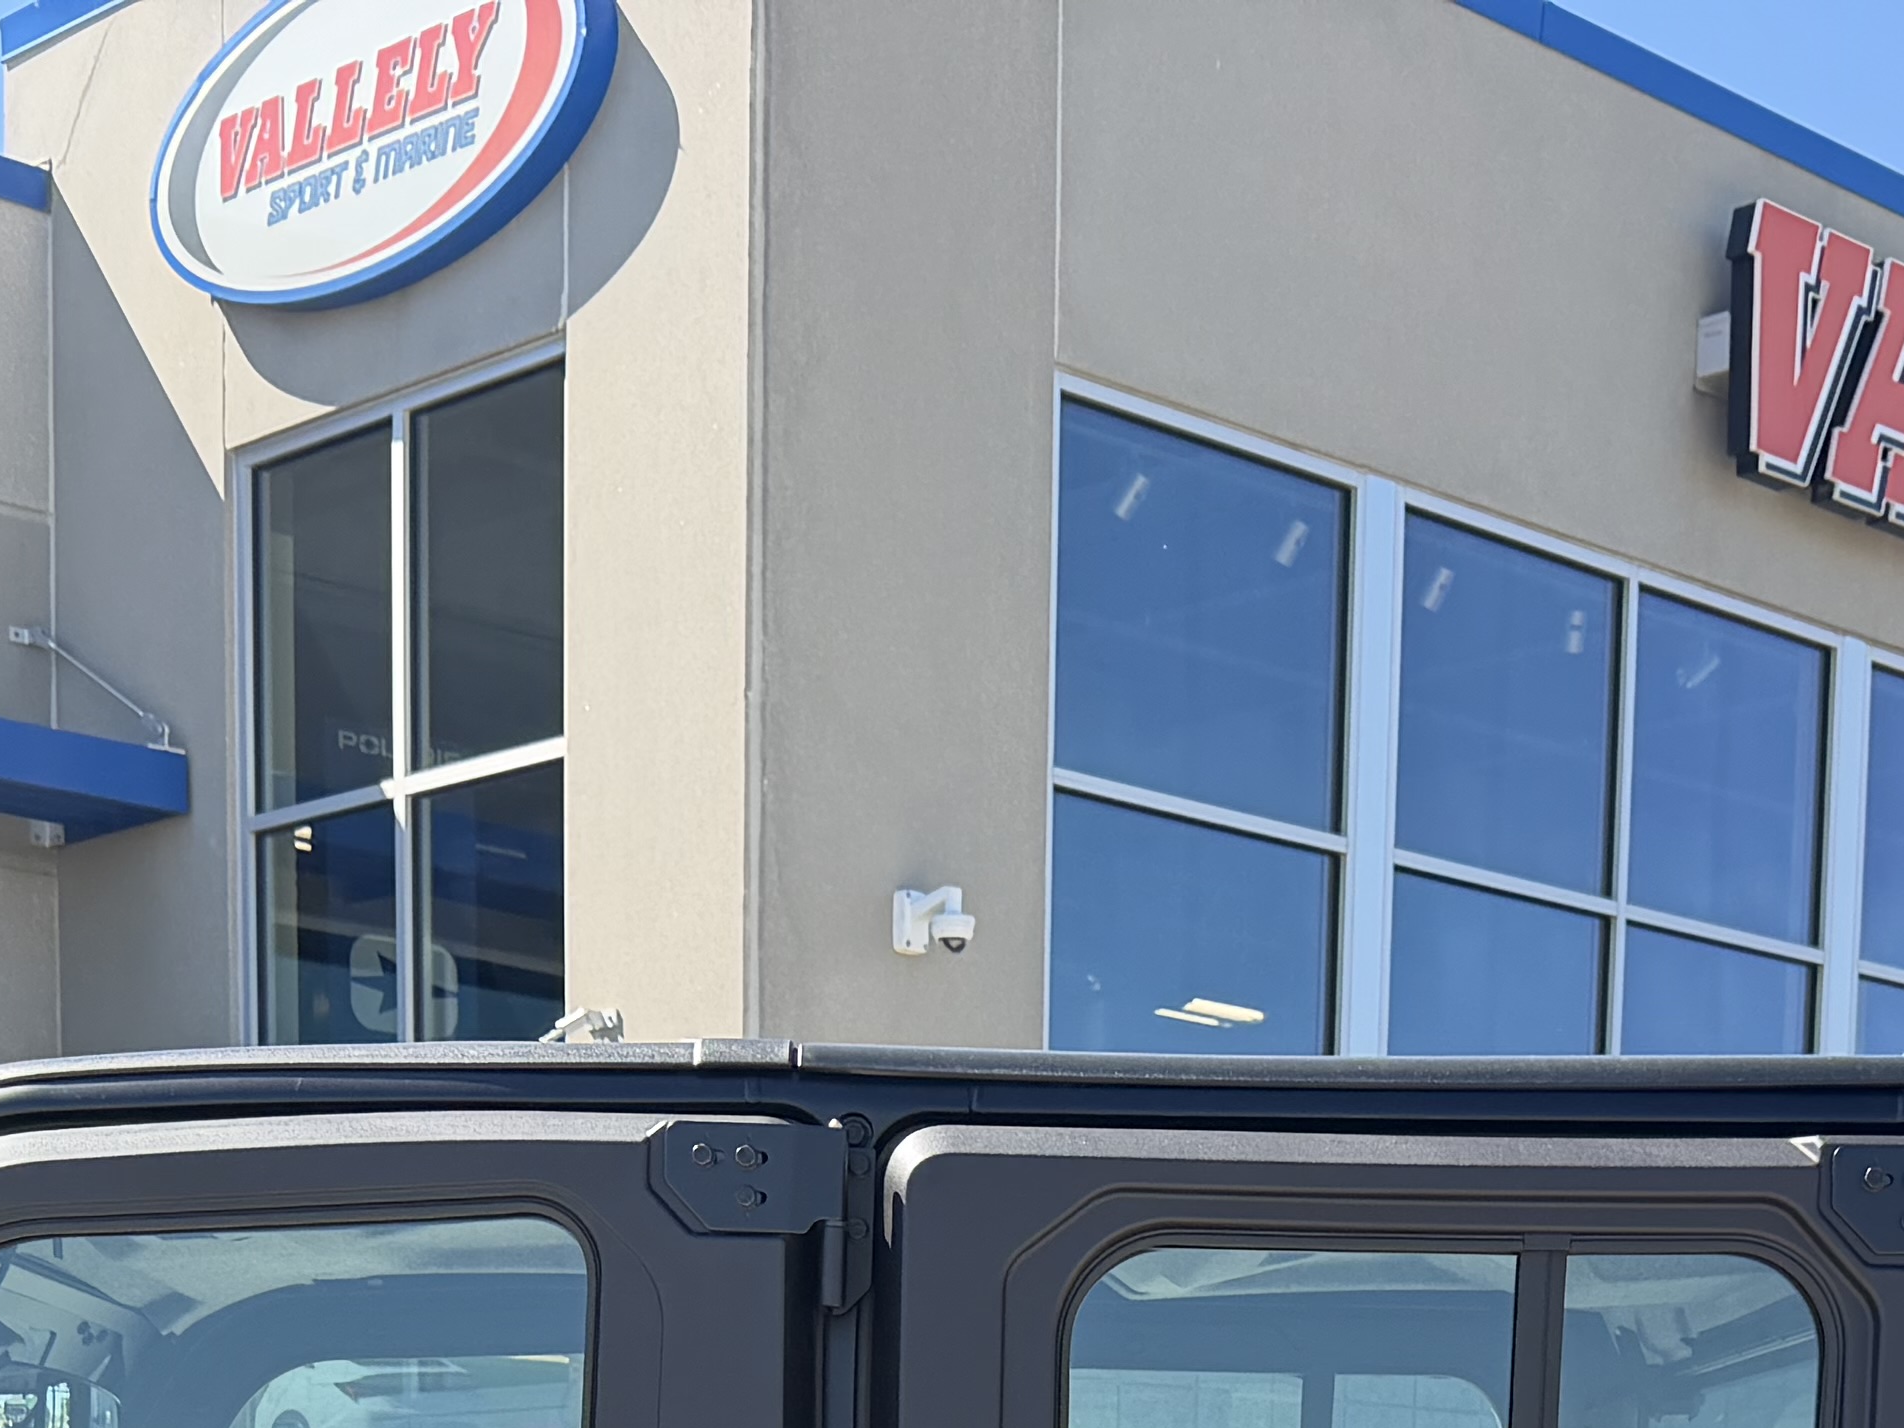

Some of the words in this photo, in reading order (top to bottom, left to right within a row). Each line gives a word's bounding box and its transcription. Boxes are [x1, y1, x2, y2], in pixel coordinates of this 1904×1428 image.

[218, 1, 500, 203] VALLELY
[267, 165, 349, 227] SPORT
[373, 108, 480, 184] MARINE
